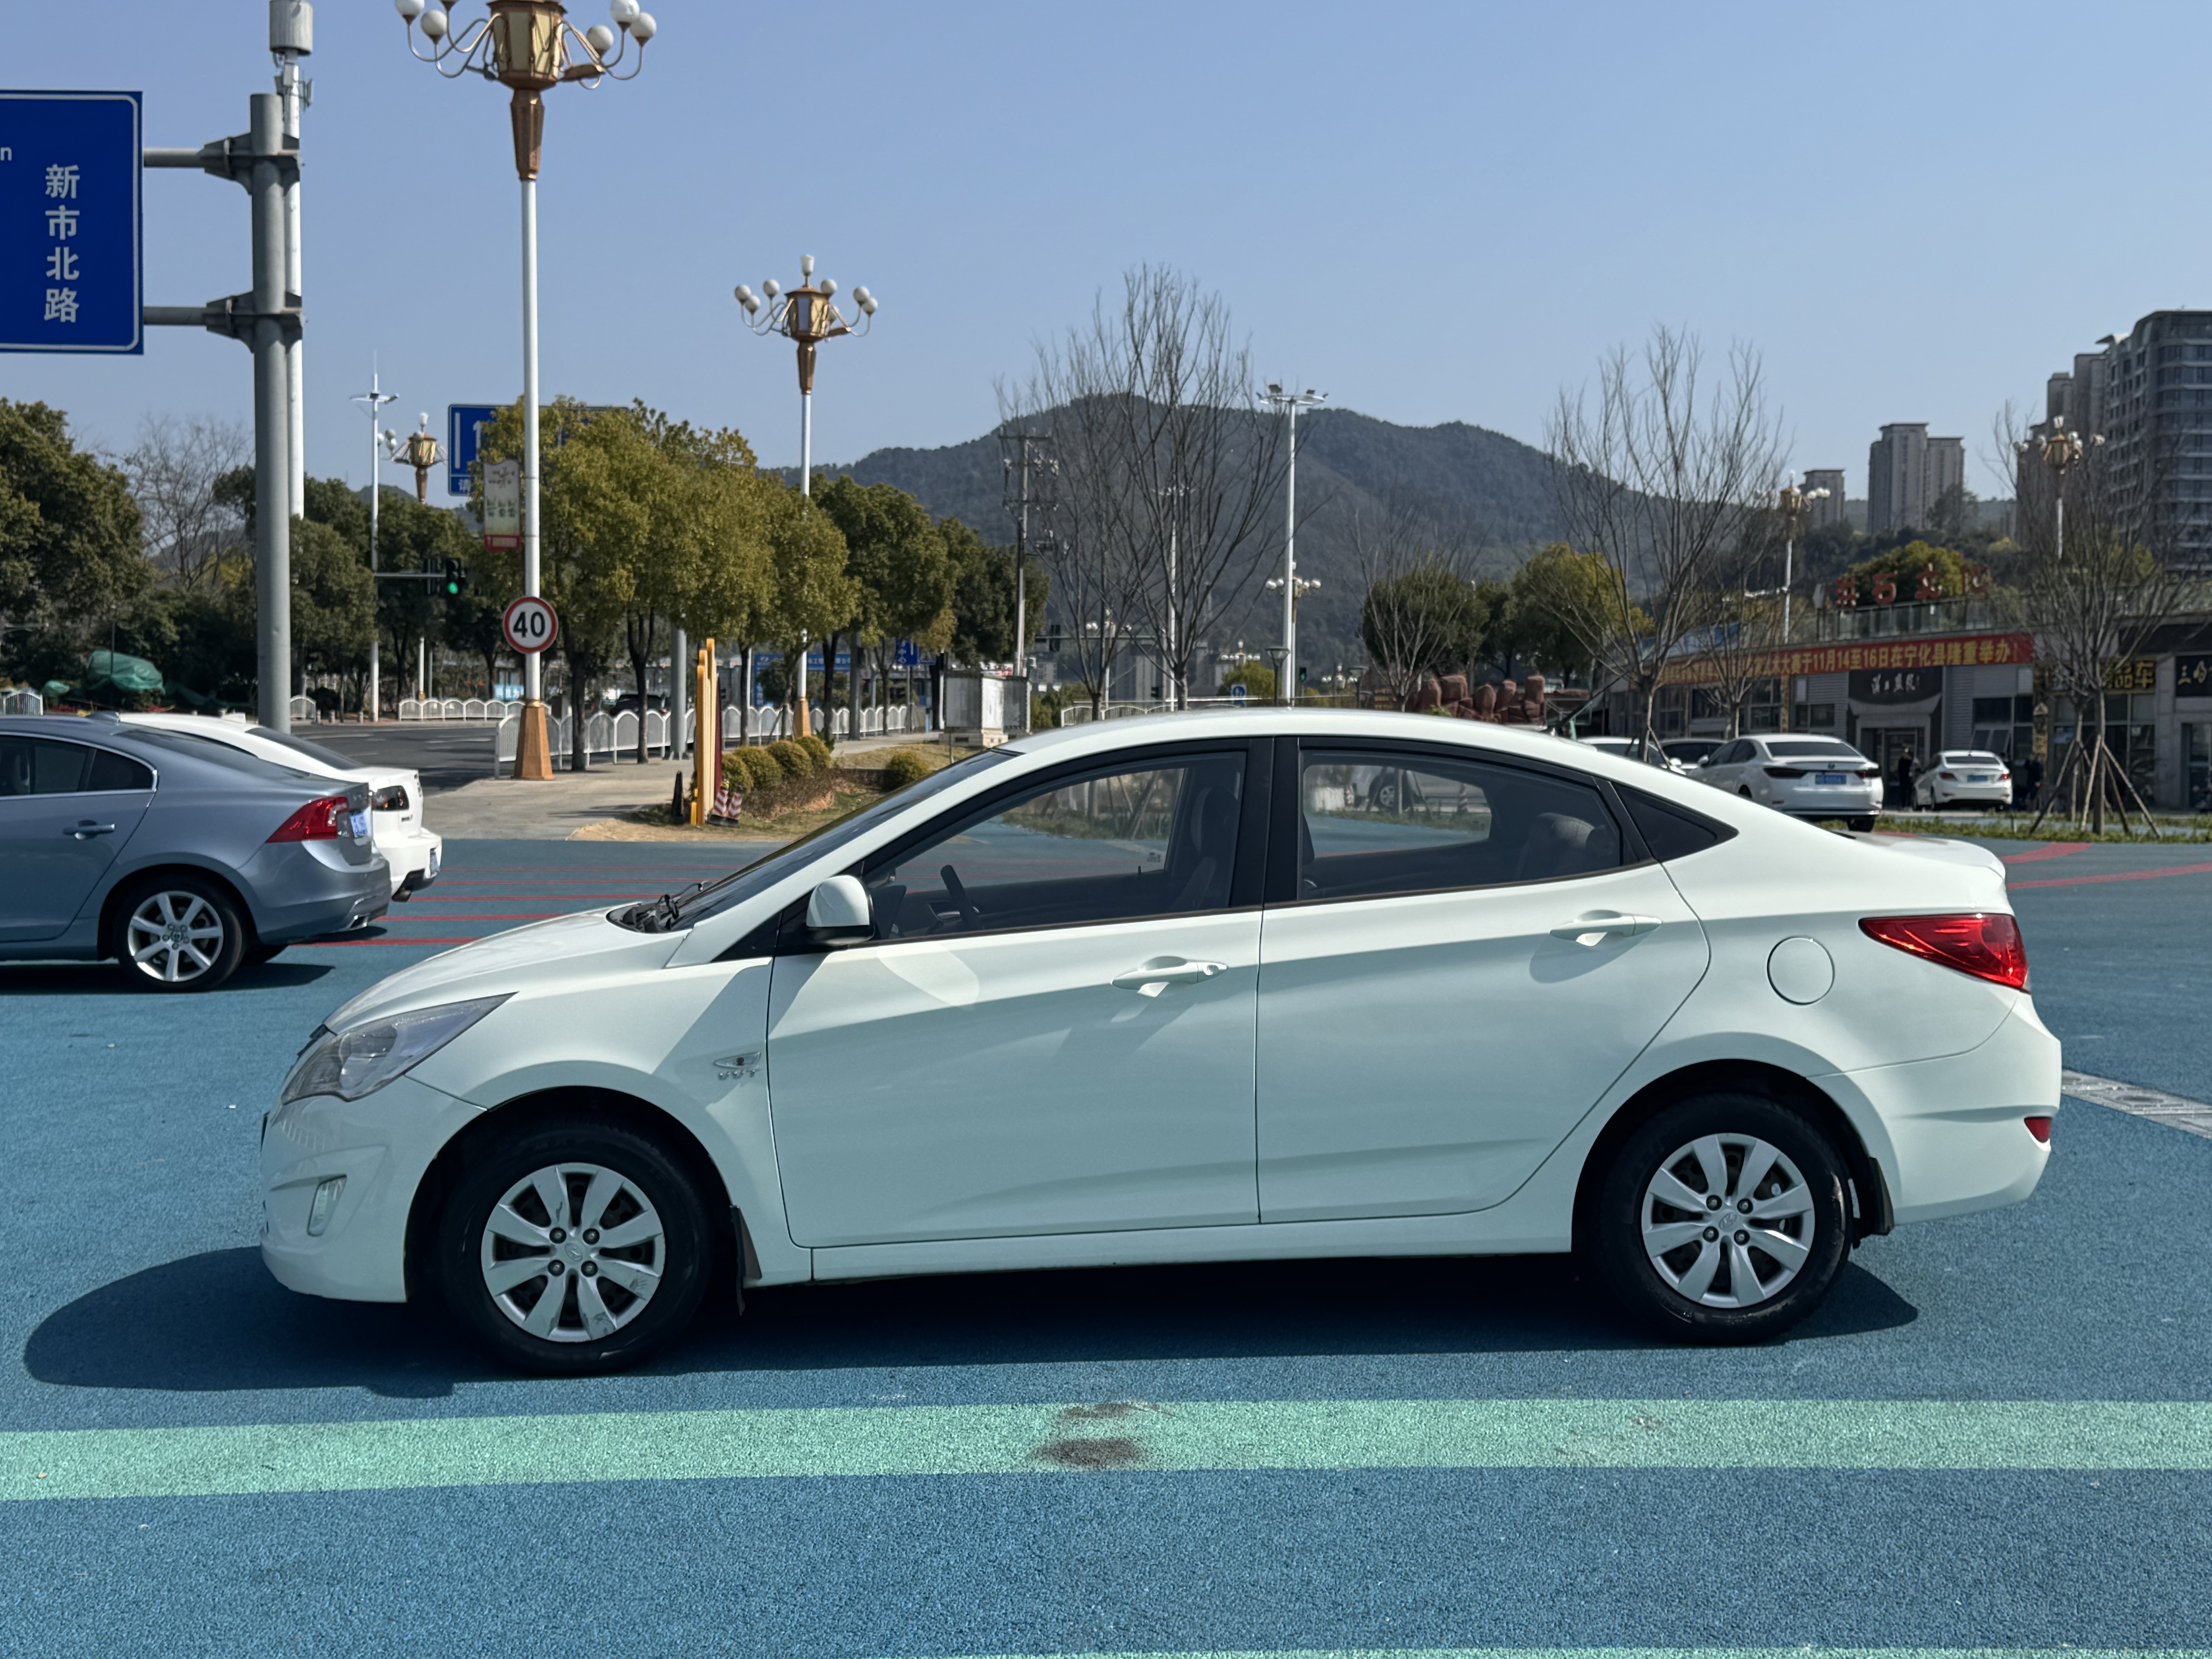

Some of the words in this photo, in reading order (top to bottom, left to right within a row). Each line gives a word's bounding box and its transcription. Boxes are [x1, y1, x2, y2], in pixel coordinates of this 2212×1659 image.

[44, 164, 81, 323] 新市北路
[513, 611, 545, 638] 40
